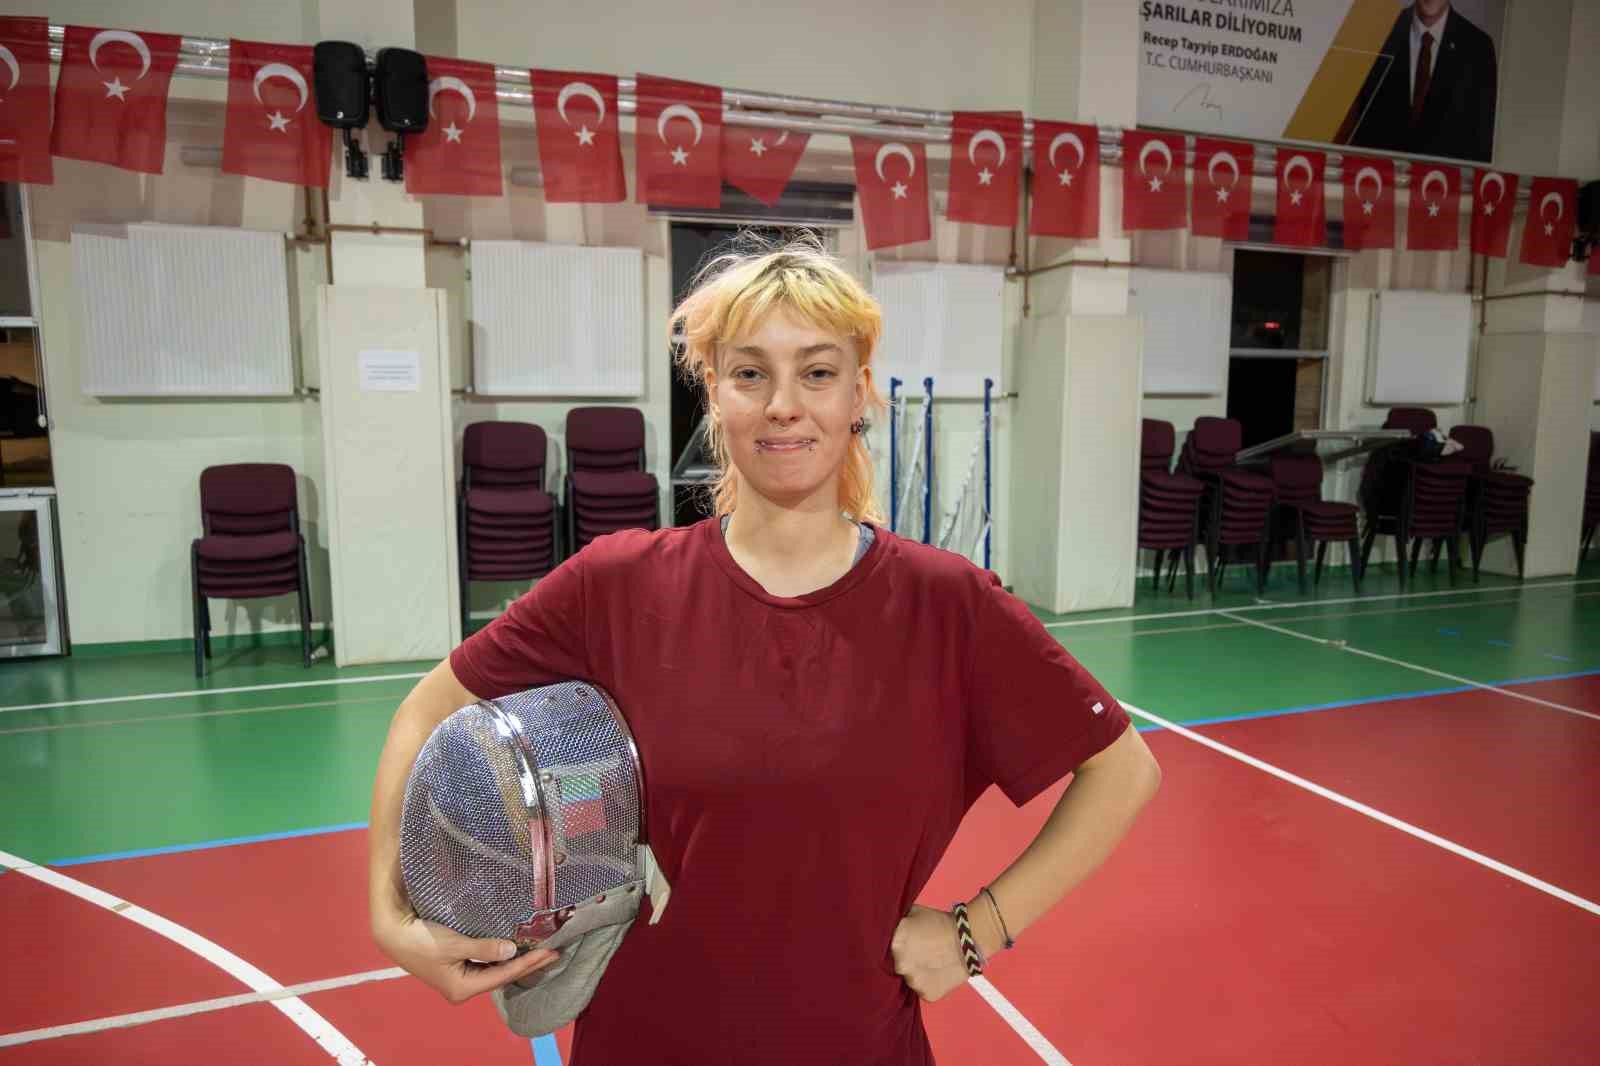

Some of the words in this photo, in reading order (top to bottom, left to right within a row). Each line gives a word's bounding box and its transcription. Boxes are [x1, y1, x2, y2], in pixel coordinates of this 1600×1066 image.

[1216, 11, 1302, 43] DİLİYORUM
[1144, 31, 1179, 51] Recep
[1181, 36, 1219, 56] Tayyip
[1221, 43, 1279, 64] ERDOĞAN
[1169, 55, 1273, 84] CUMHURBAŞKANI
